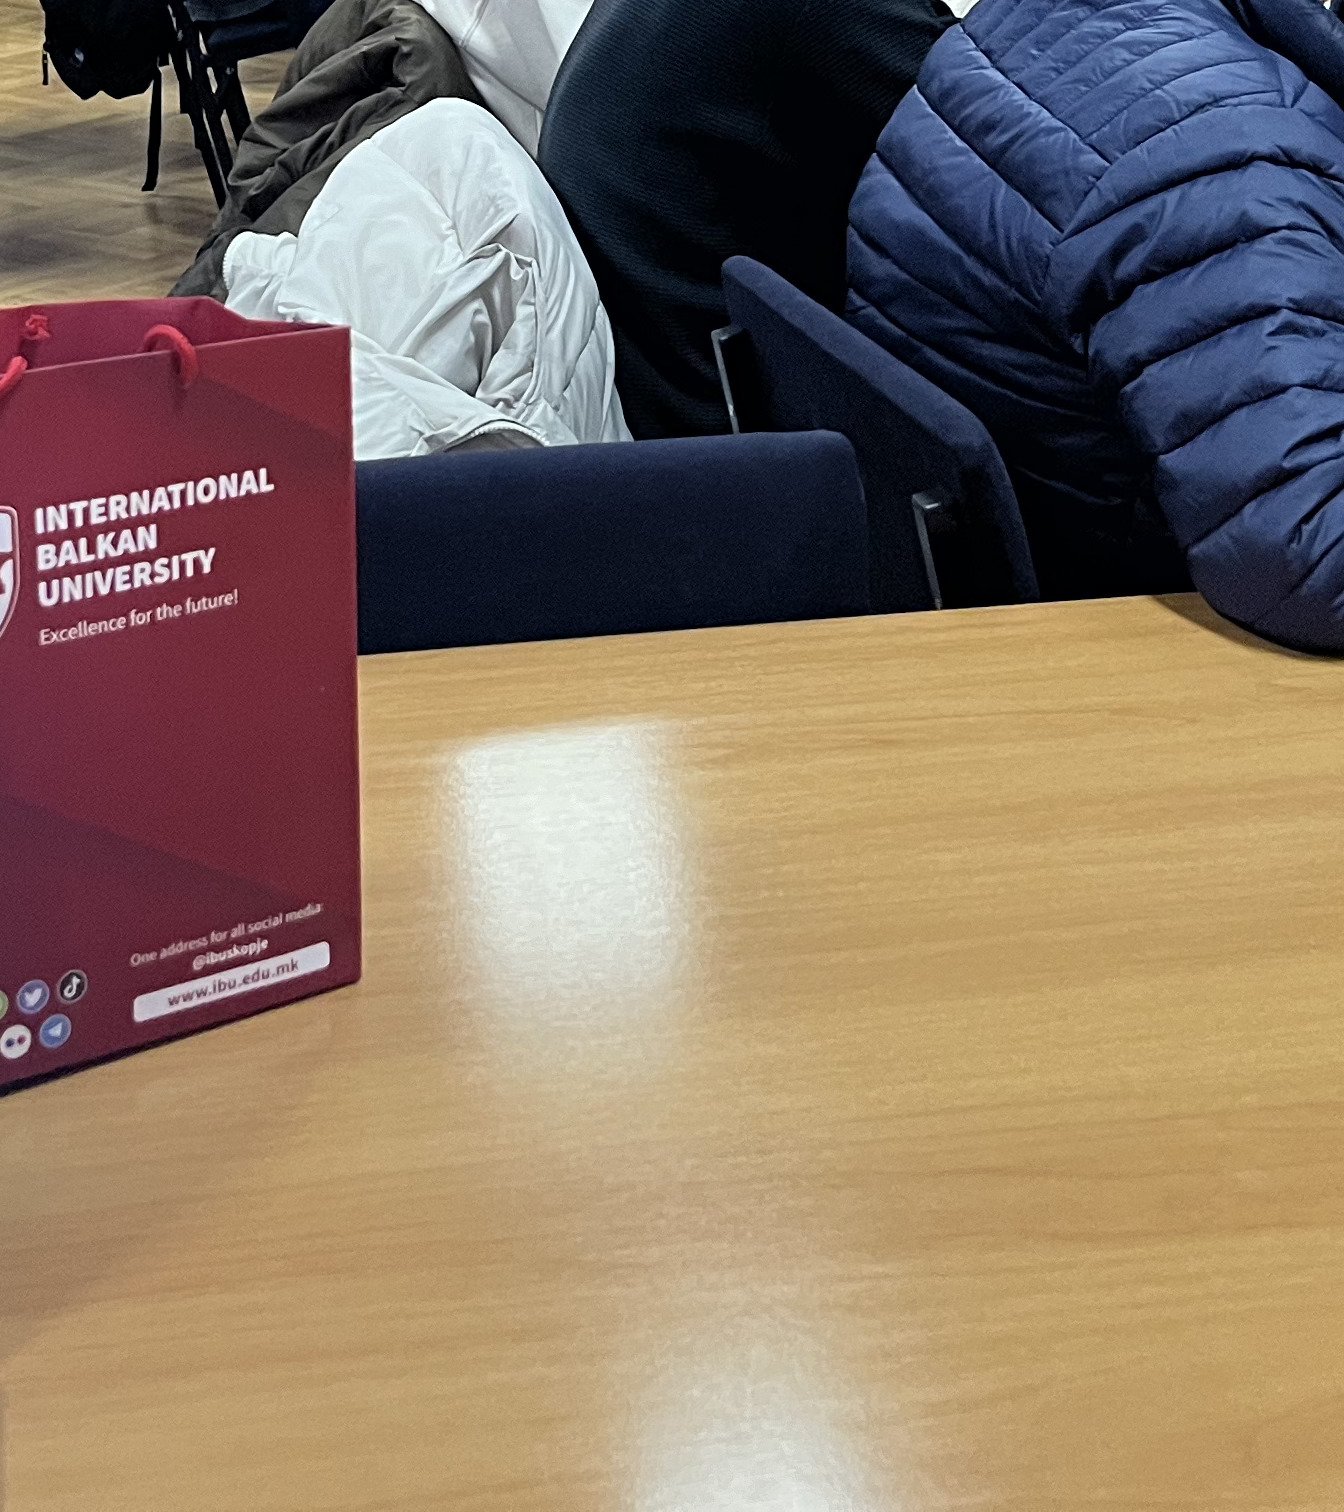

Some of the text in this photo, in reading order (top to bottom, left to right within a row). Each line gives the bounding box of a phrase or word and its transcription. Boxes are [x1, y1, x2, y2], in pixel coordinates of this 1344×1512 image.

[34, 467, 275, 534] INTERNATIONAL
[36, 524, 159, 572] BALKAN
[37, 547, 216, 608] UNIVERSITY
[38, 589, 239, 647] Excellence for the future!
[130, 950, 157, 967] One
[160, 935, 208, 959] address
[210, 928, 228, 944] for
[231, 922, 245, 939] all
[248, 912, 283, 932] social
[193, 938, 269, 971] @ibuskopje
[168, 958, 299, 1007] www.ibu.edu.mk
